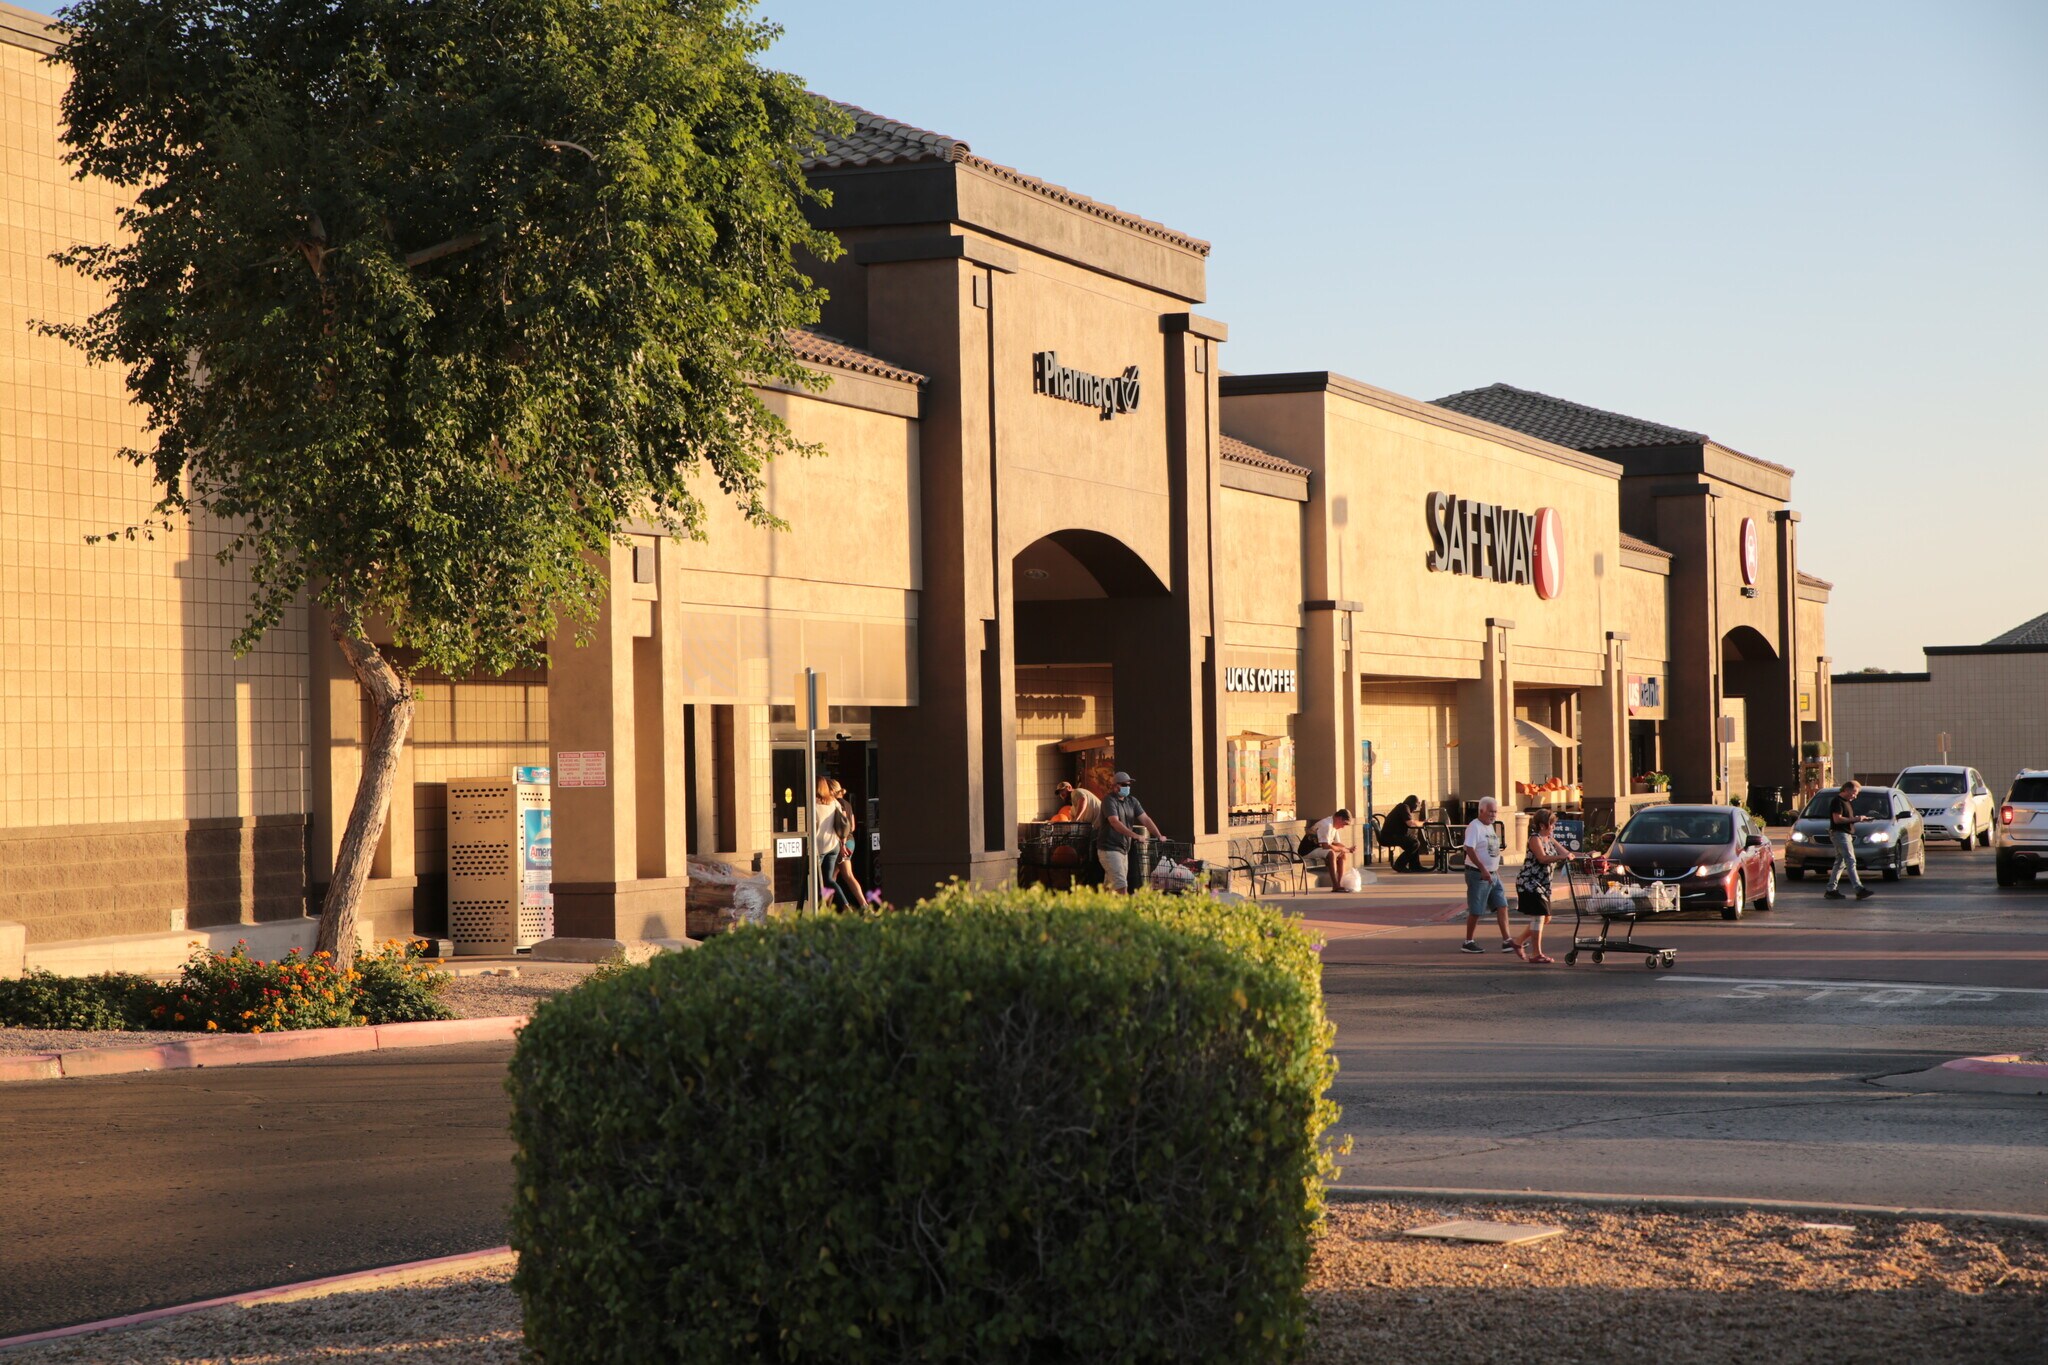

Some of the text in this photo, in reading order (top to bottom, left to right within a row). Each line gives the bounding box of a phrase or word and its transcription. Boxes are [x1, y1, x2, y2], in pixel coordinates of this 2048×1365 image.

[1043, 351, 1118, 419] Pharmacy
[1428, 491, 1536, 585] SAFEWAY
[1225, 667, 1295, 692] UCKS COFFEE
[778, 842, 801, 854] ENTER
